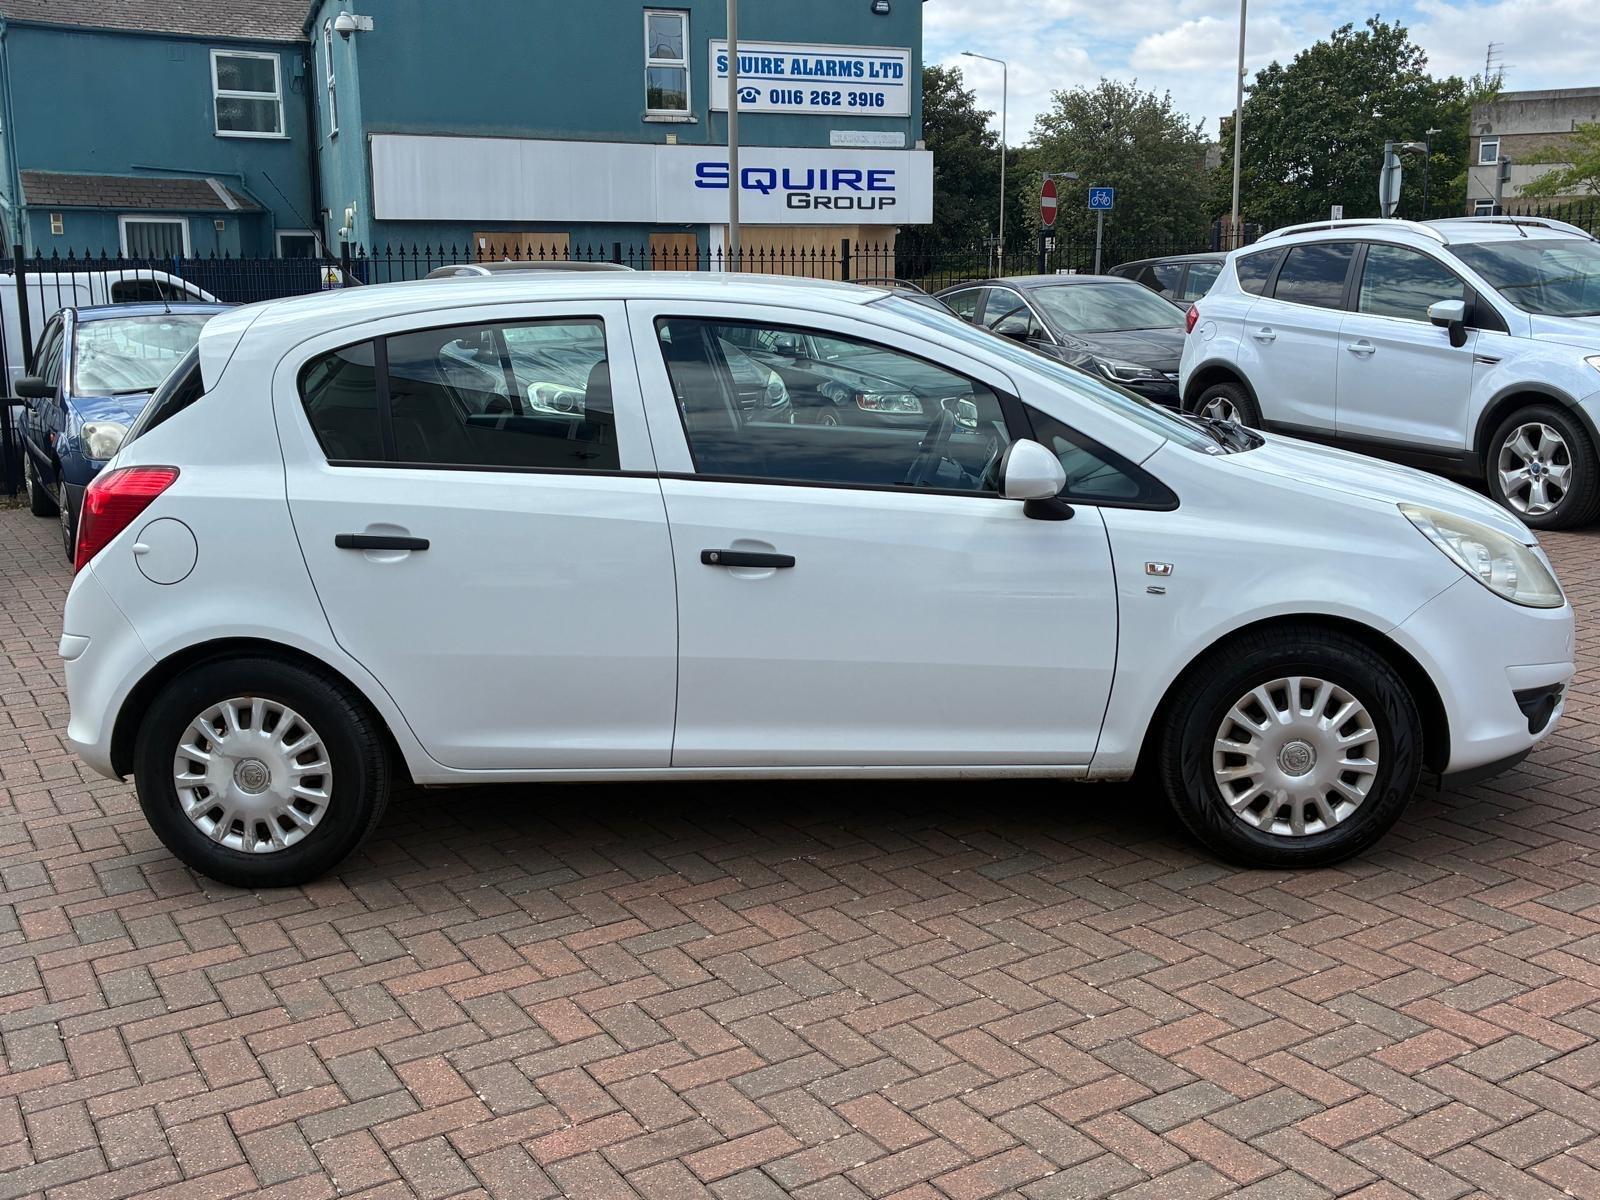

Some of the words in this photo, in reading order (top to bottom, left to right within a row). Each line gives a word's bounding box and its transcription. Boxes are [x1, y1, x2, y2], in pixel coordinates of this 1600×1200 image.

[717, 55, 785, 75] SUIRE
[790, 58, 864, 78] ALARMS
[869, 62, 903, 79] LTD
[769, 89, 803, 105] 0116
[810, 91, 841, 106] 262
[848, 92, 885, 107] 3916
[694, 162, 896, 195] SQUIRE
[786, 192, 896, 210] GROUP
